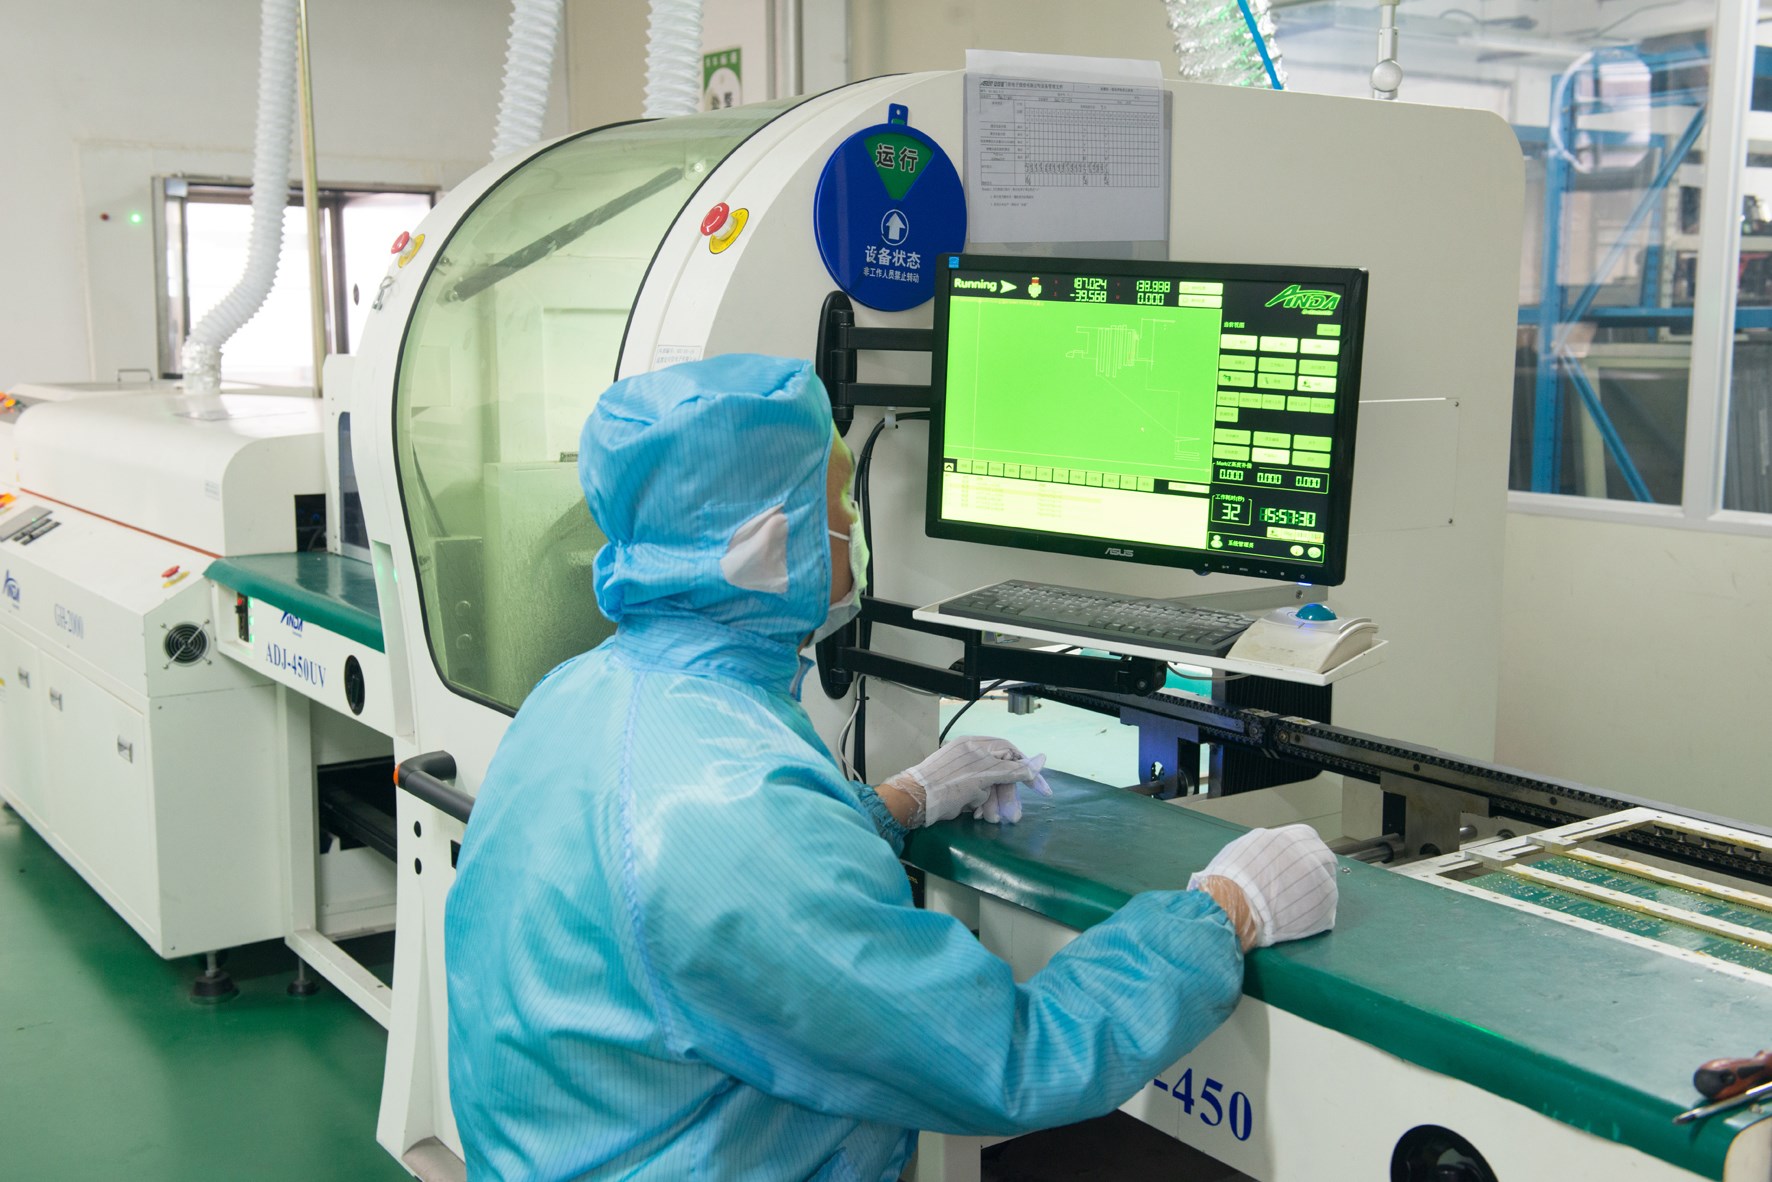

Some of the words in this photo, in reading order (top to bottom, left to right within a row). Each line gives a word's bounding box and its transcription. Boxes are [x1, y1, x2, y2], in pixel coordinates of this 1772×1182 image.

[875, 143, 918, 173] 运行
[865, 245, 921, 269] 设备状态
[863, 267, 920, 284] 非工作人员禁止转动
[954, 278, 997, 292] Running
[1073, 277, 1107, 290] 187.024
[1069, 290, 1107, 303] -39.568
[1137, 292, 1164, 305] 0.000
[1264, 284, 1341, 309] ANDA
[1219, 469, 1244, 481] 0.000
[1257, 472, 1282, 485] 0.000
[1295, 476, 1320, 489] 0.000
[1221, 502, 1240, 521] 32
[1263, 507, 1316, 528] 15:57:30
[1104, 547, 1134, 557] ASUS
[266, 641, 326, 688] ADJ-450UV
